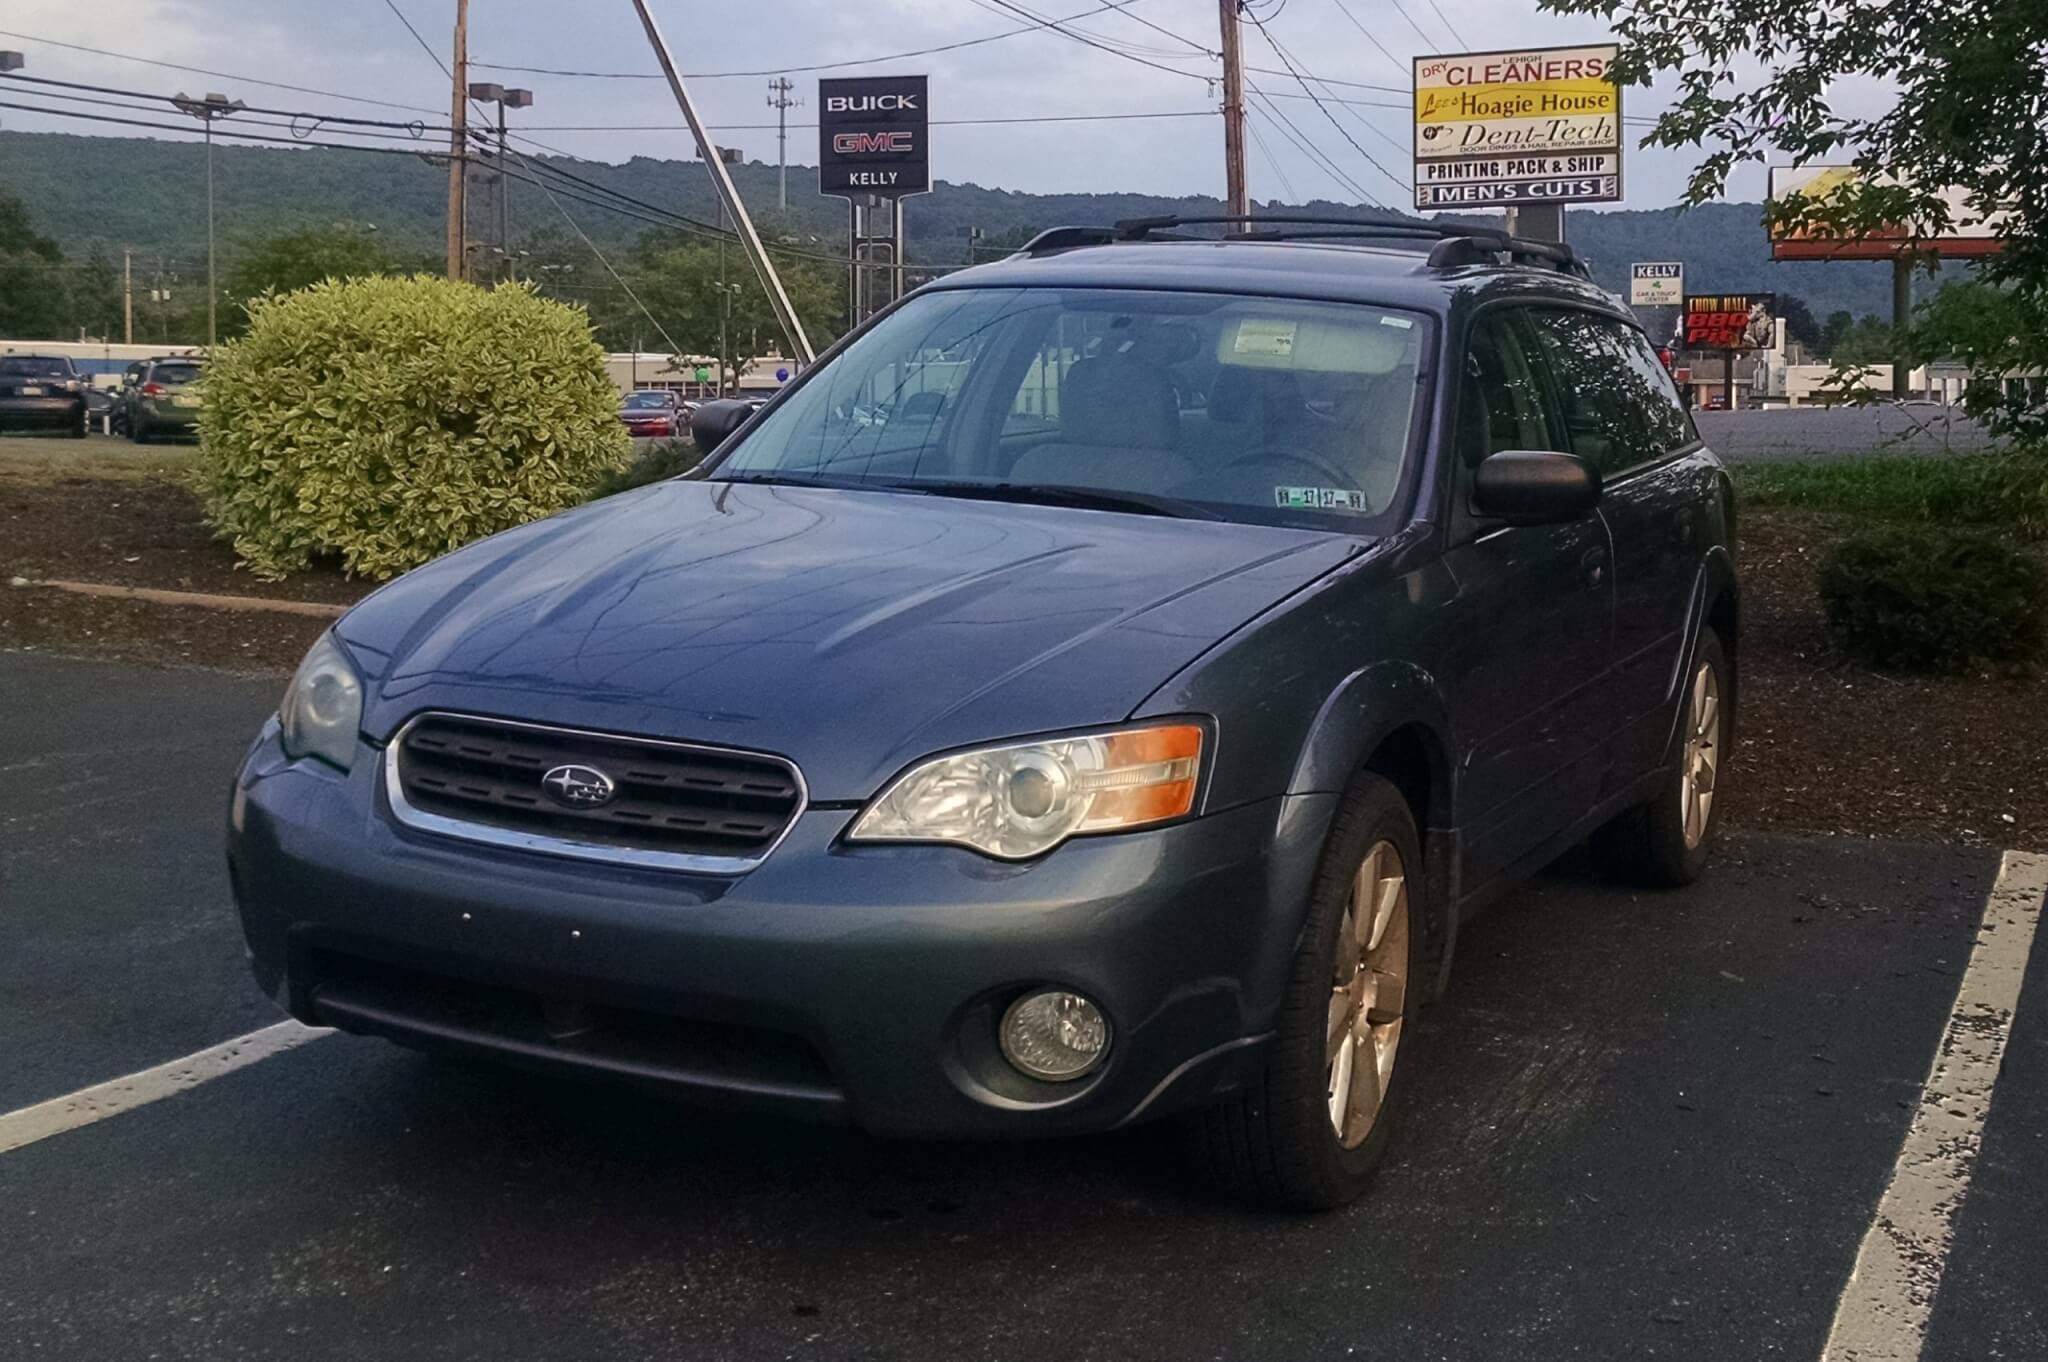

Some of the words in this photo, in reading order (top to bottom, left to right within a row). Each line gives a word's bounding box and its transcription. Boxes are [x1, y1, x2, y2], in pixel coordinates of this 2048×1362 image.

[1502, 55, 1542, 65] LEHIGH
[1421, 61, 1448, 78] DRY
[1446, 58, 1603, 86] CLEANERS
[827, 95, 919, 112] BUICK
[1461, 91, 1533, 118] Hoagie
[1541, 93, 1609, 111] House
[1457, 116, 1615, 147] Dent-Tech
[833, 132, 913, 153] GMC
[1459, 145, 1487, 153] DOOR
[1488, 143, 1518, 151] DINGS
[1428, 161, 1504, 179] PRINTING,
[1507, 159, 1547, 175] PACK
[1552, 160, 1562, 173] &
[1568, 156, 1604, 172] SHIP
[849, 172, 898, 185] KELLY
[1439, 184, 1517, 201] MEN'S
[1528, 180, 1594, 196] CUTS
[1637, 265, 1676, 278] KELLY
[1689, 297, 1718, 313] CHOW
[1724, 296, 1747, 312] HALL
[1687, 312, 1748, 327] BBQ
